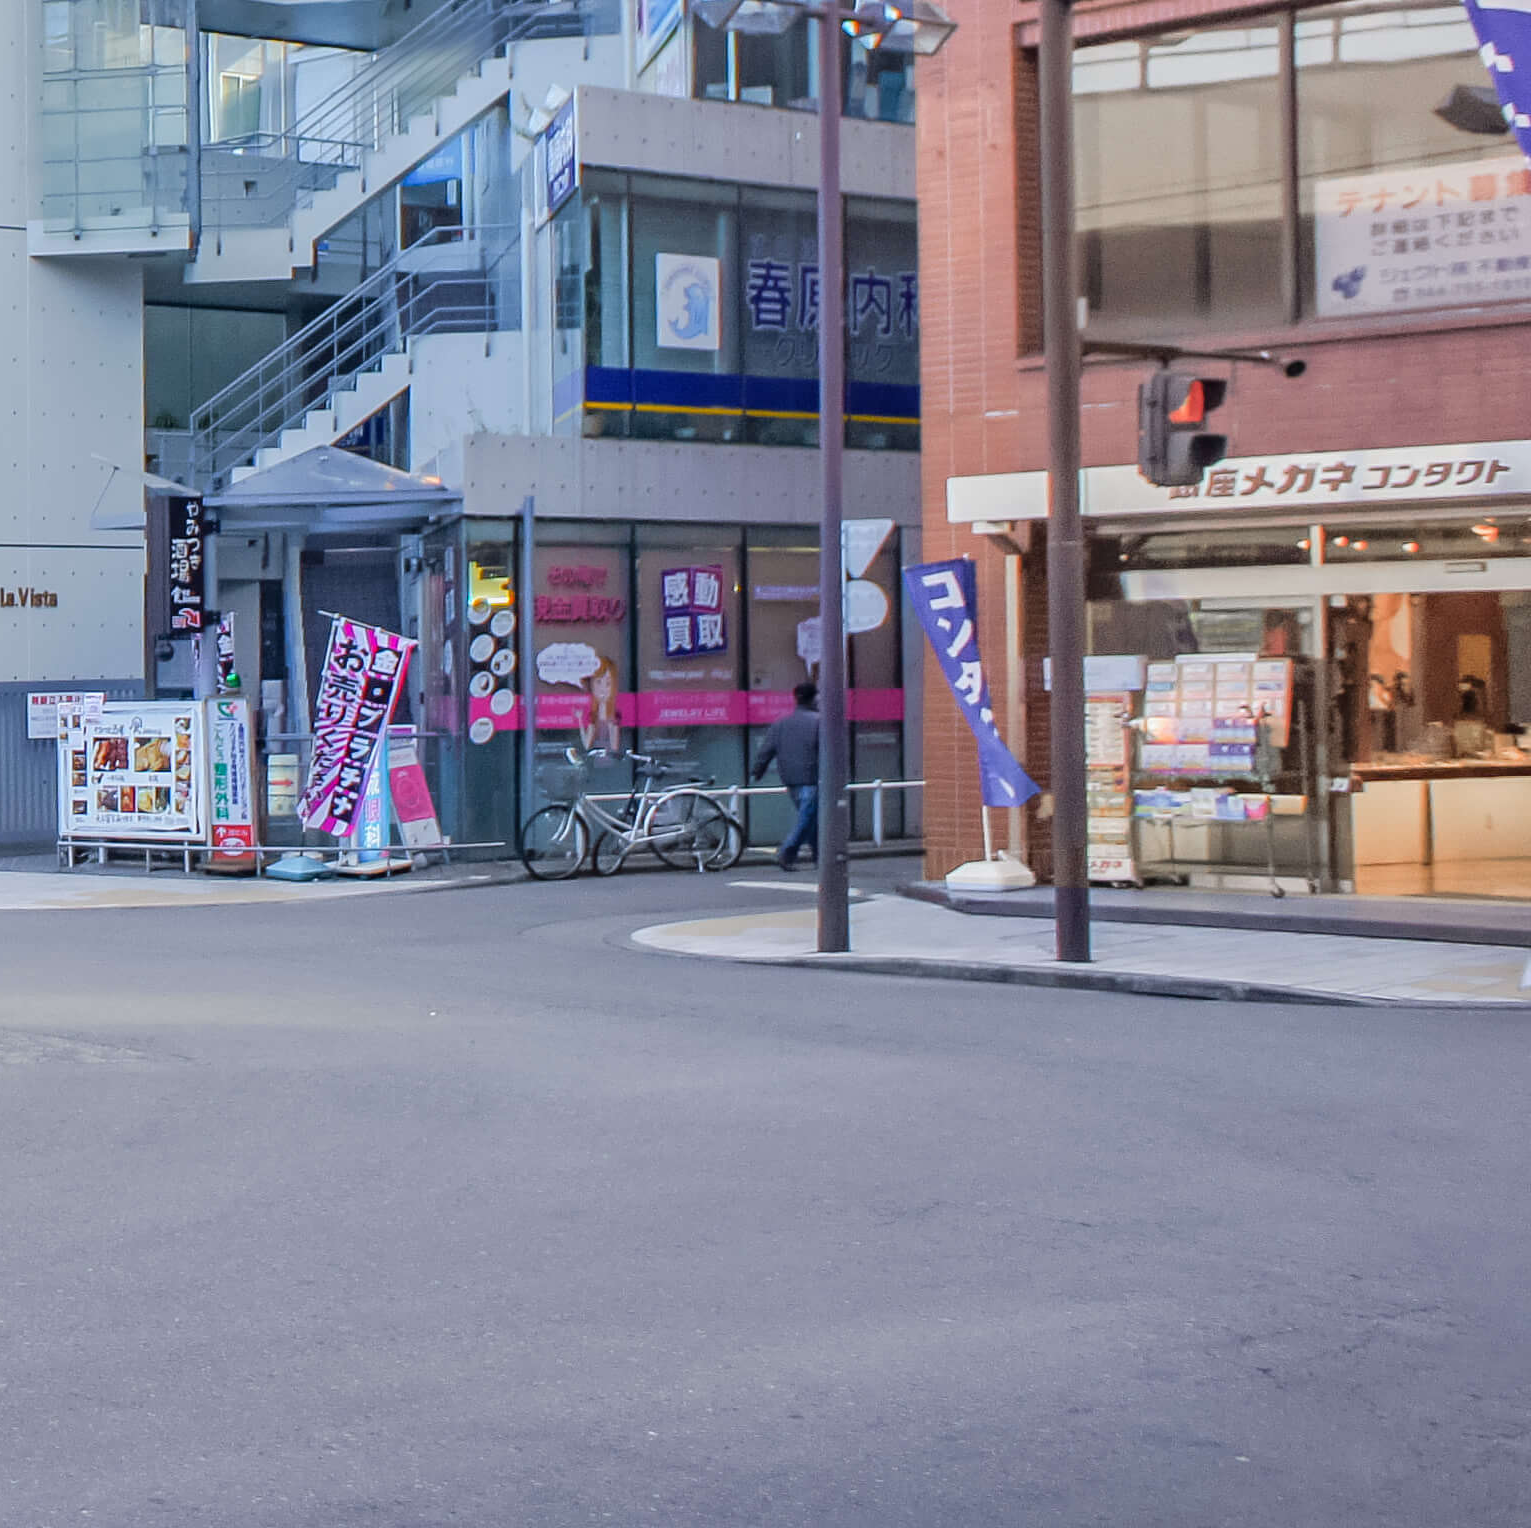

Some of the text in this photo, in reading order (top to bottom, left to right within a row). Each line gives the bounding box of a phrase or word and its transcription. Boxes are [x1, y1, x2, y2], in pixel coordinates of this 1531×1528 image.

[1361, 458, 1513, 491] コンタクト
